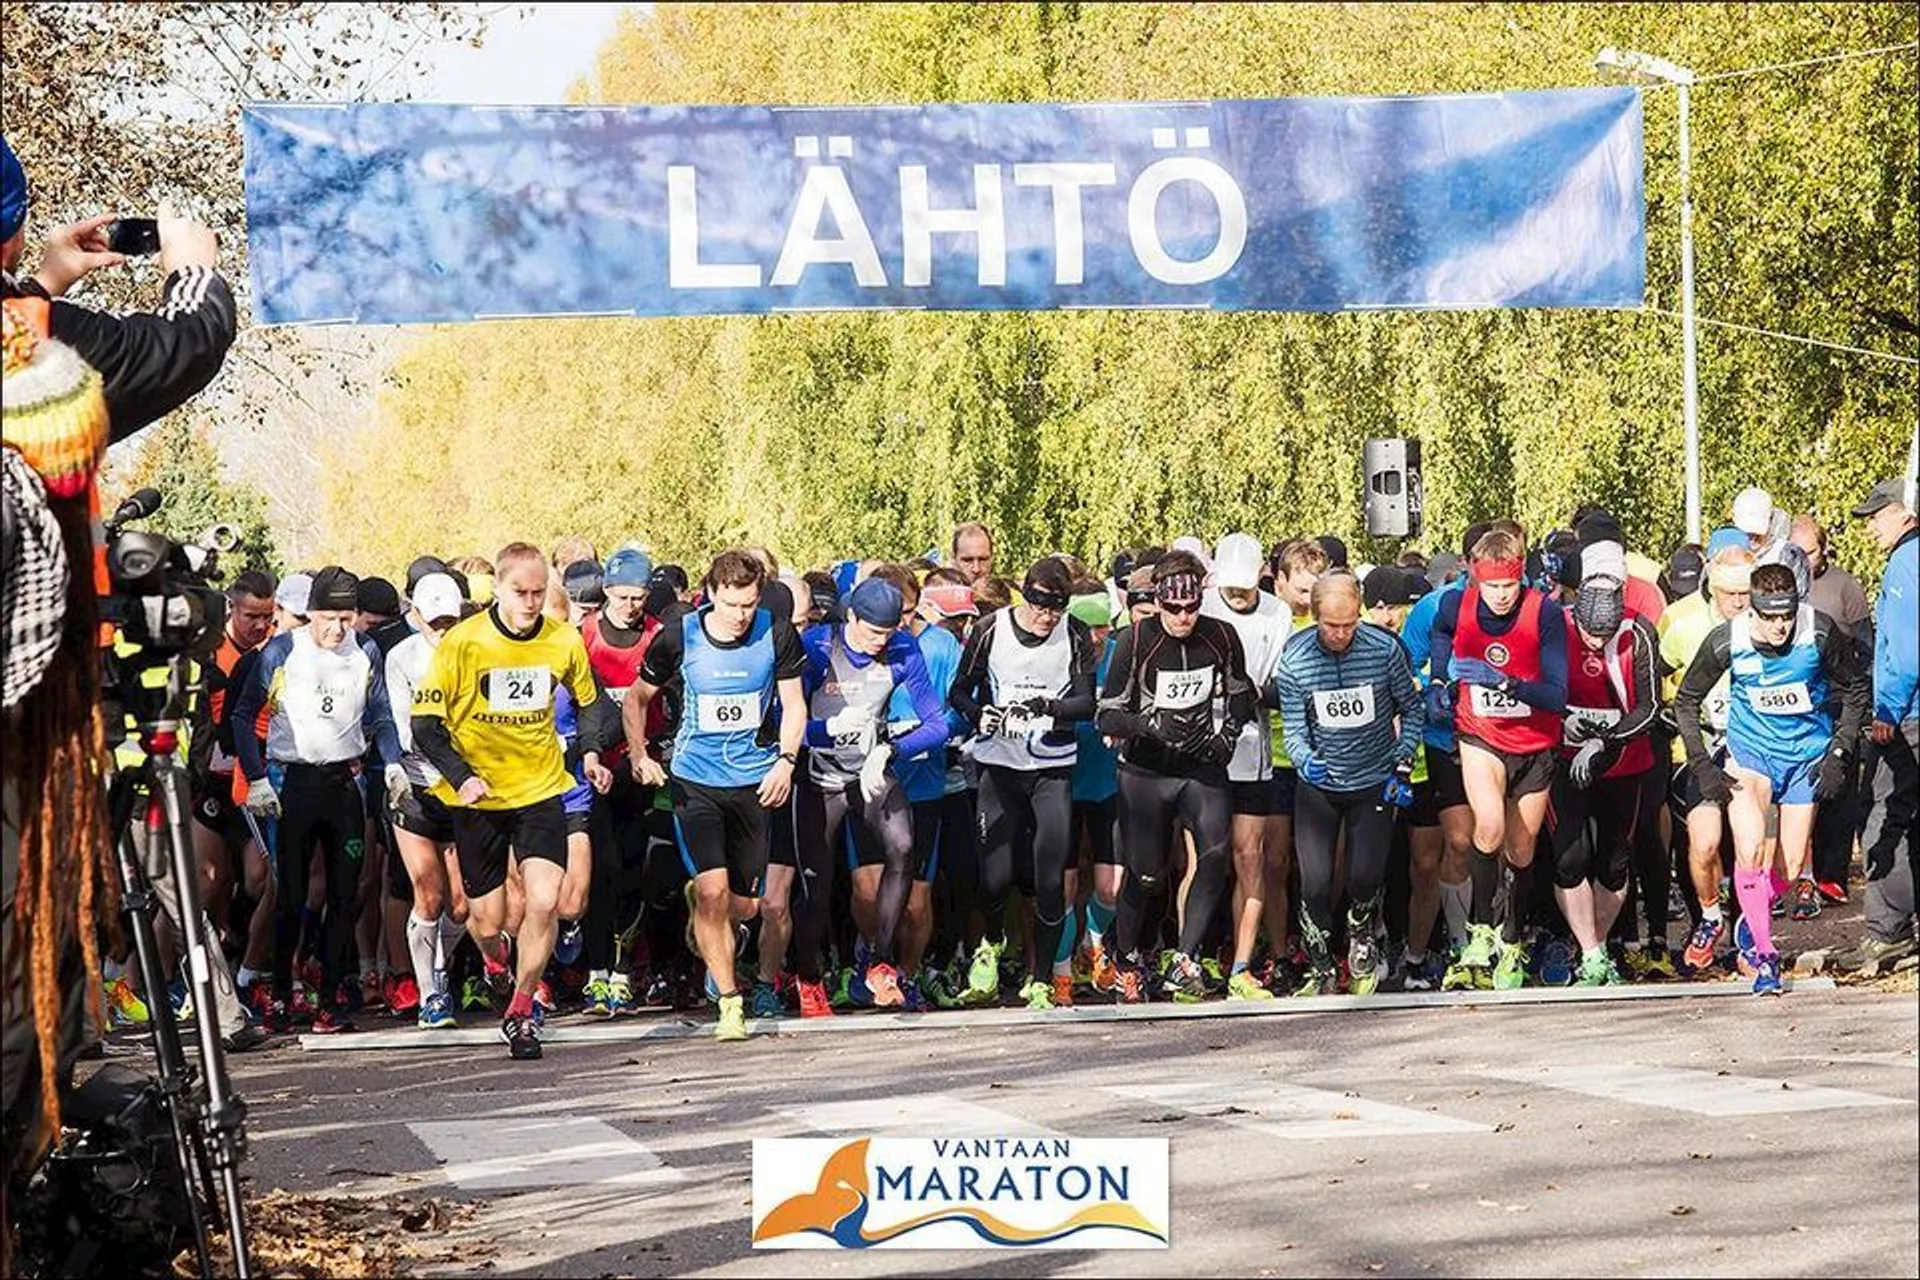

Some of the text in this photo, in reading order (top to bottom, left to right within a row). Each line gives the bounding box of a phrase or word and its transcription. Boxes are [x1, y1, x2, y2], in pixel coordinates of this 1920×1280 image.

[667, 127, 1248, 289] LÄHTÖ
[507, 680, 534, 700] 24
[1166, 680, 1203, 699] 377
[321, 695, 334, 714] 8
[716, 705, 743, 722] 69
[1326, 698, 1365, 718] 680
